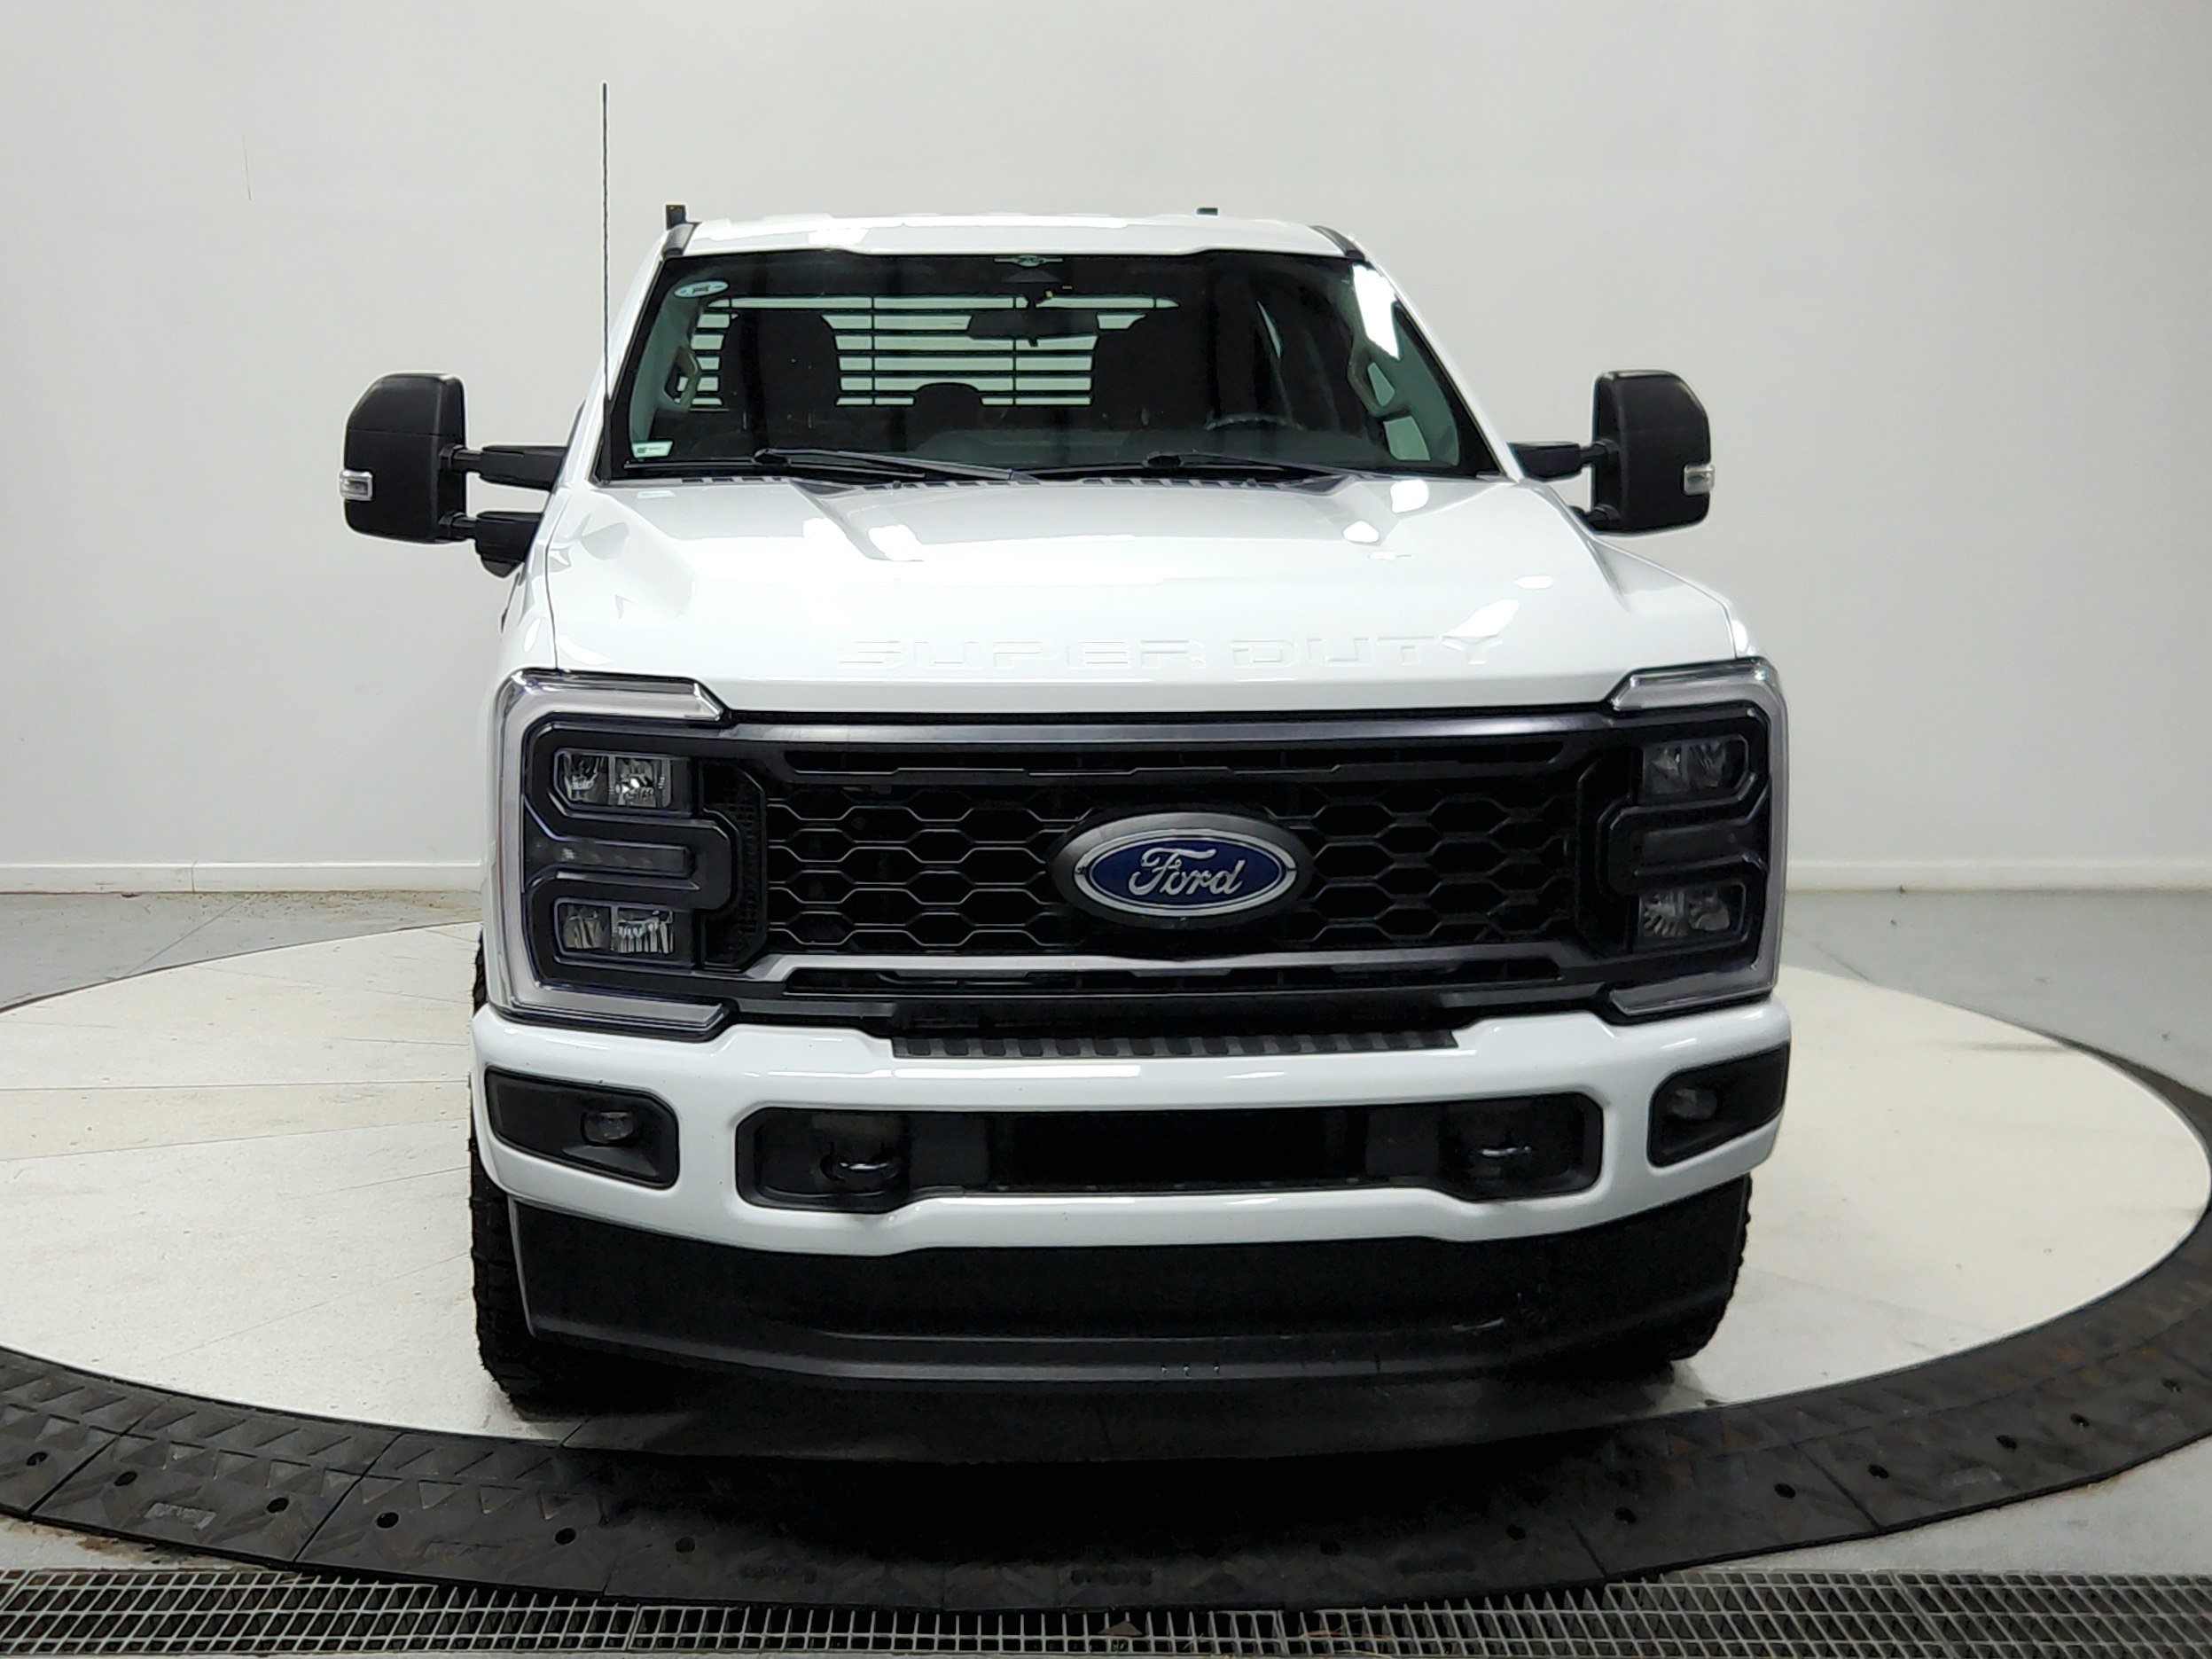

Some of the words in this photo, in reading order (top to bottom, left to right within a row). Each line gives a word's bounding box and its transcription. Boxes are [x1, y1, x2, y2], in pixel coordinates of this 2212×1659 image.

[837, 638, 1207, 669] SUPER
[1230, 634, 1504, 669] DUTY
[1128, 846, 1247, 896] Ford
